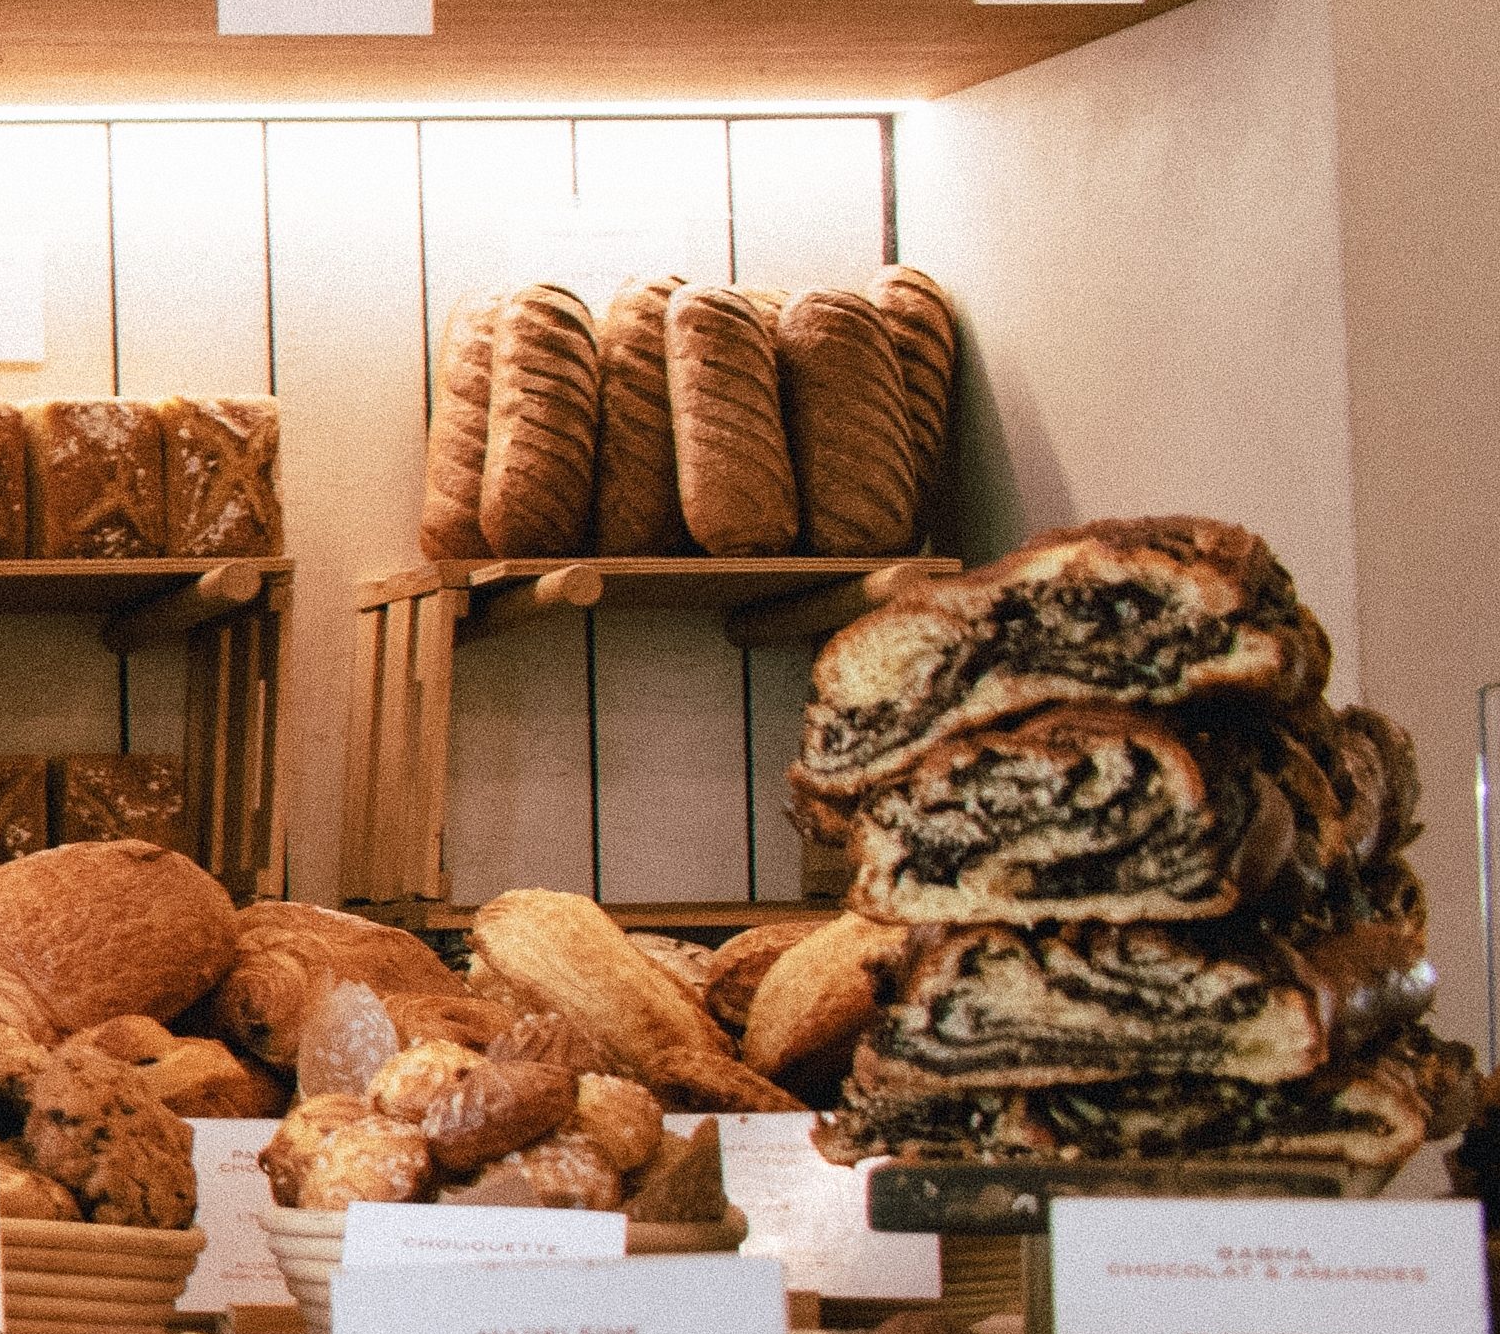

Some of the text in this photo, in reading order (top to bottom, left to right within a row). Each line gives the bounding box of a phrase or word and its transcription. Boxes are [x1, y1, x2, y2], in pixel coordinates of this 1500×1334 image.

[401, 1236, 557, 1256] CHOUQUETTE
[1106, 1262, 1253, 1279] CHOCOLAT
[1290, 1265, 1428, 1285] AMANDES
